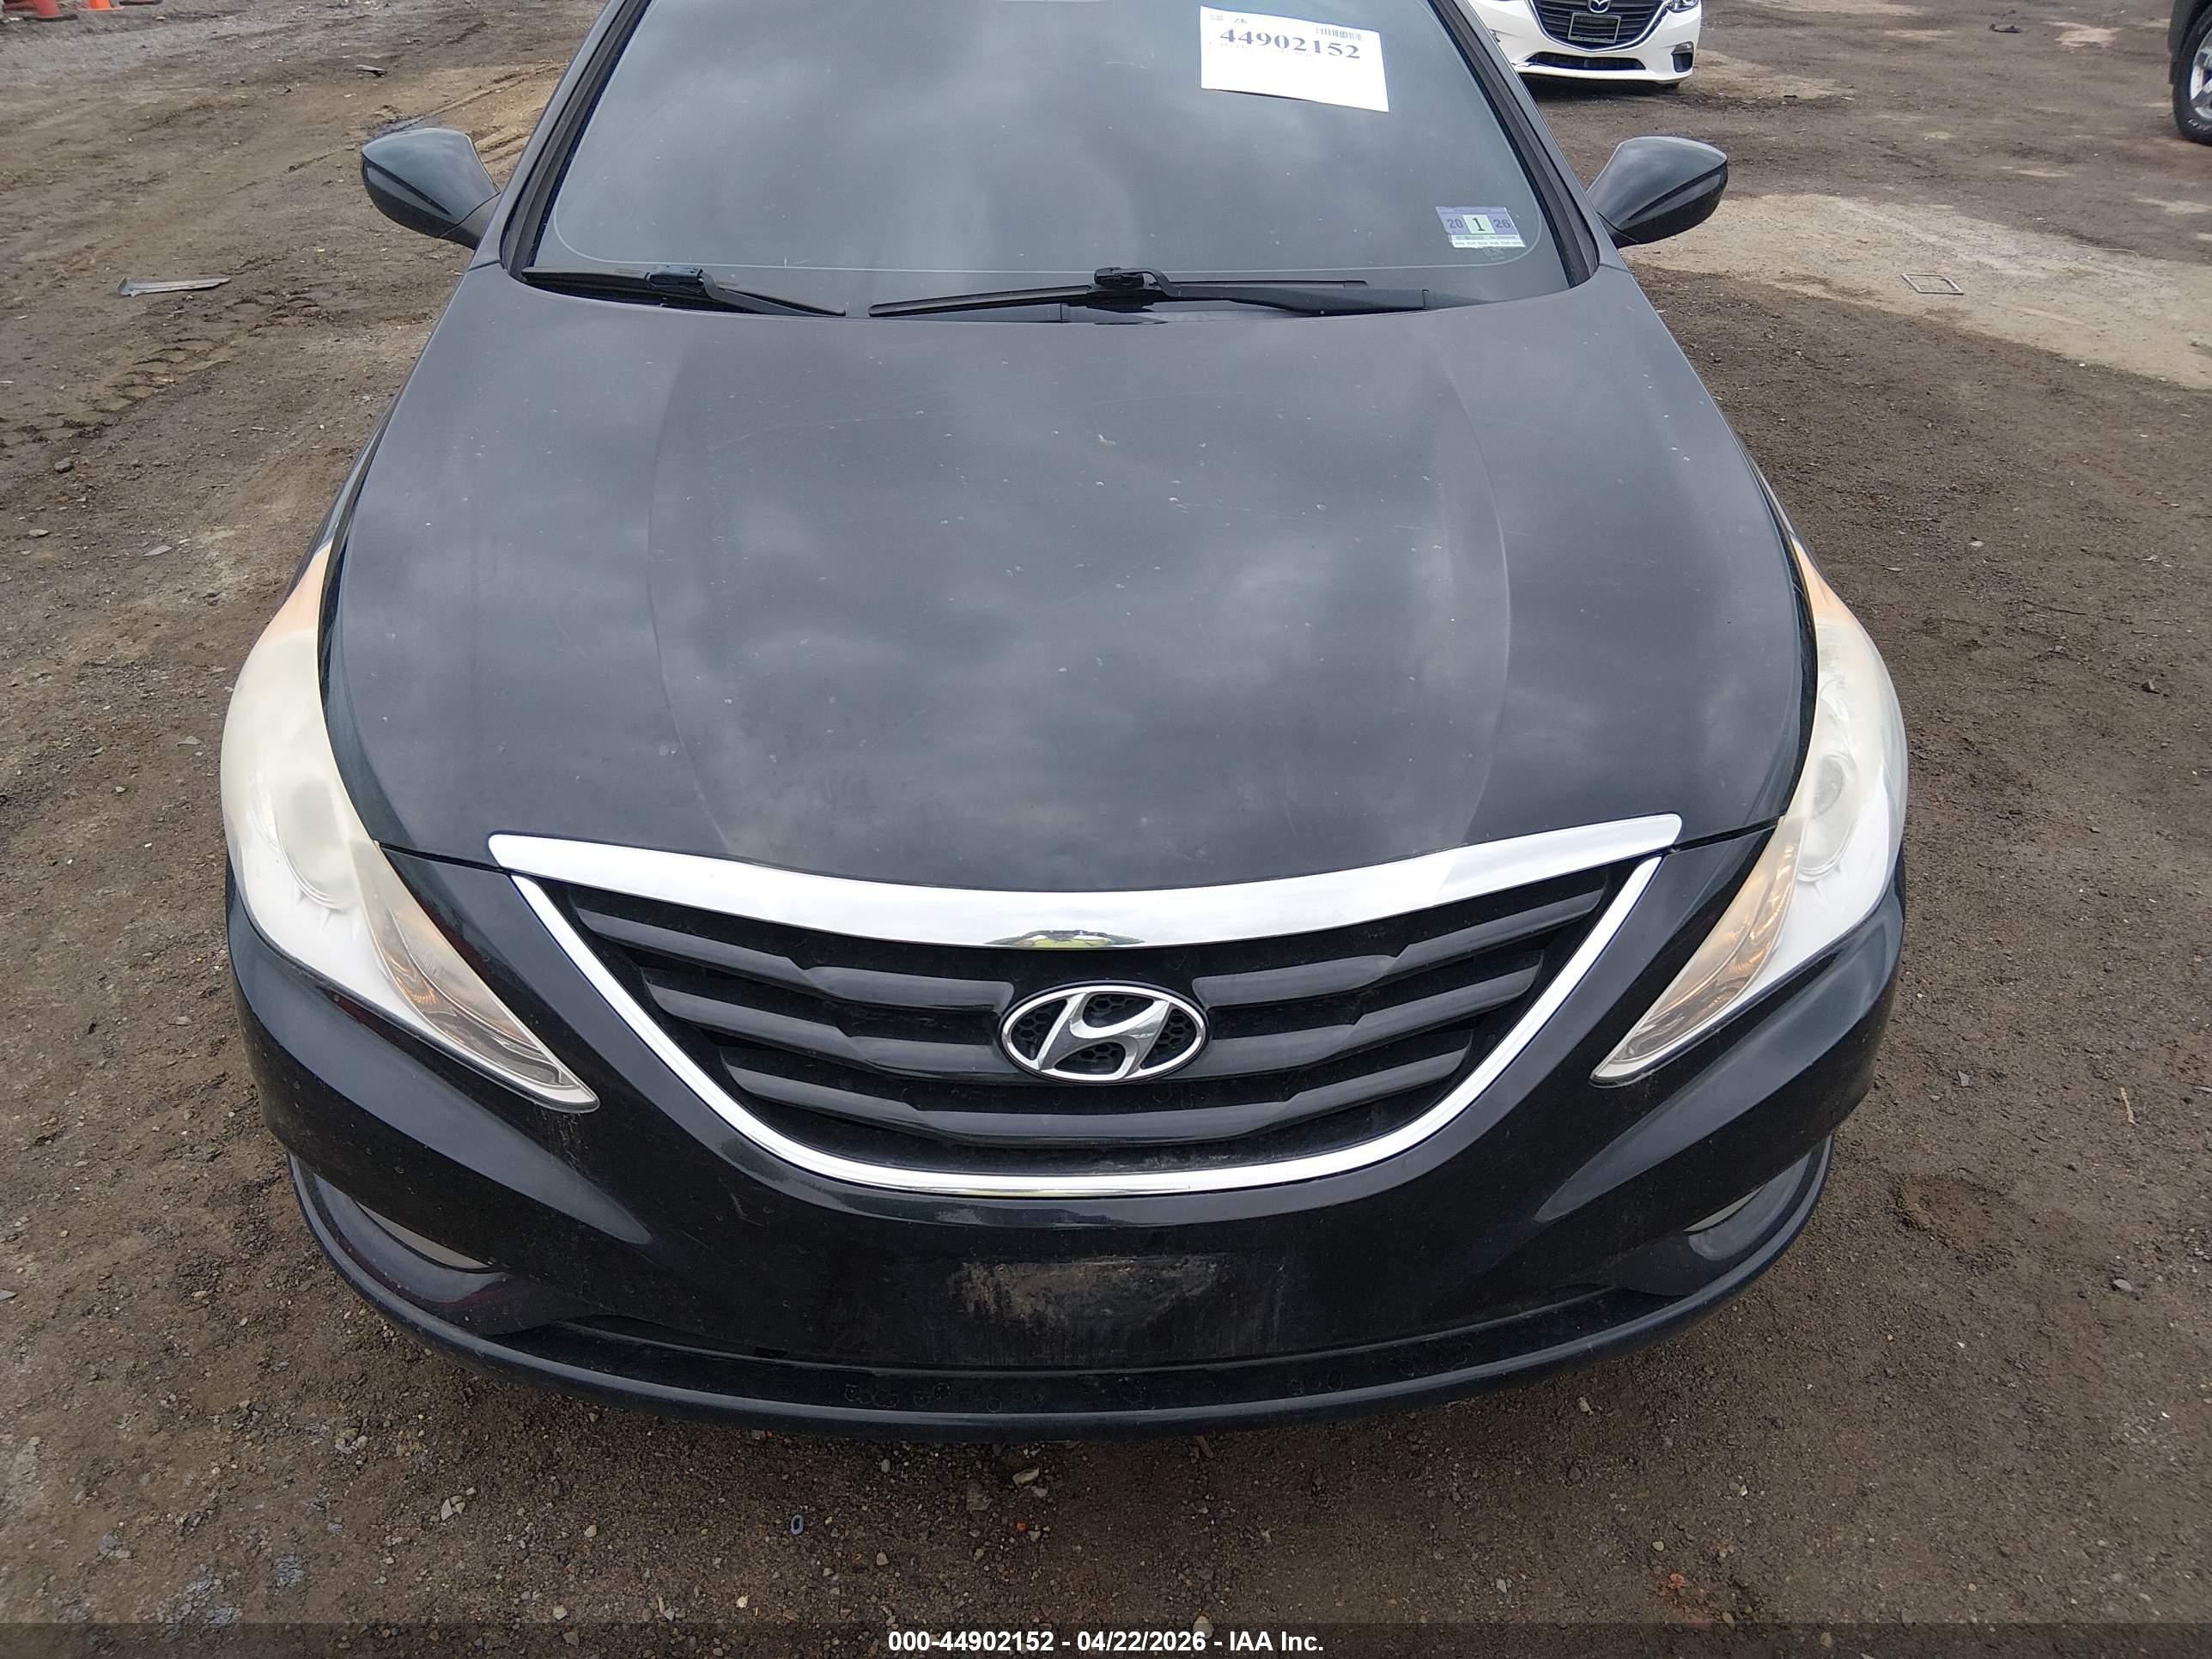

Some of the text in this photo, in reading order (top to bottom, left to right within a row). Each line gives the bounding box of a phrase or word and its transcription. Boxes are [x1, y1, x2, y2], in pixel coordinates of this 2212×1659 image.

[1219, 28, 1360, 59] 44902152
[1447, 216, 1511, 232] 20 1 26
